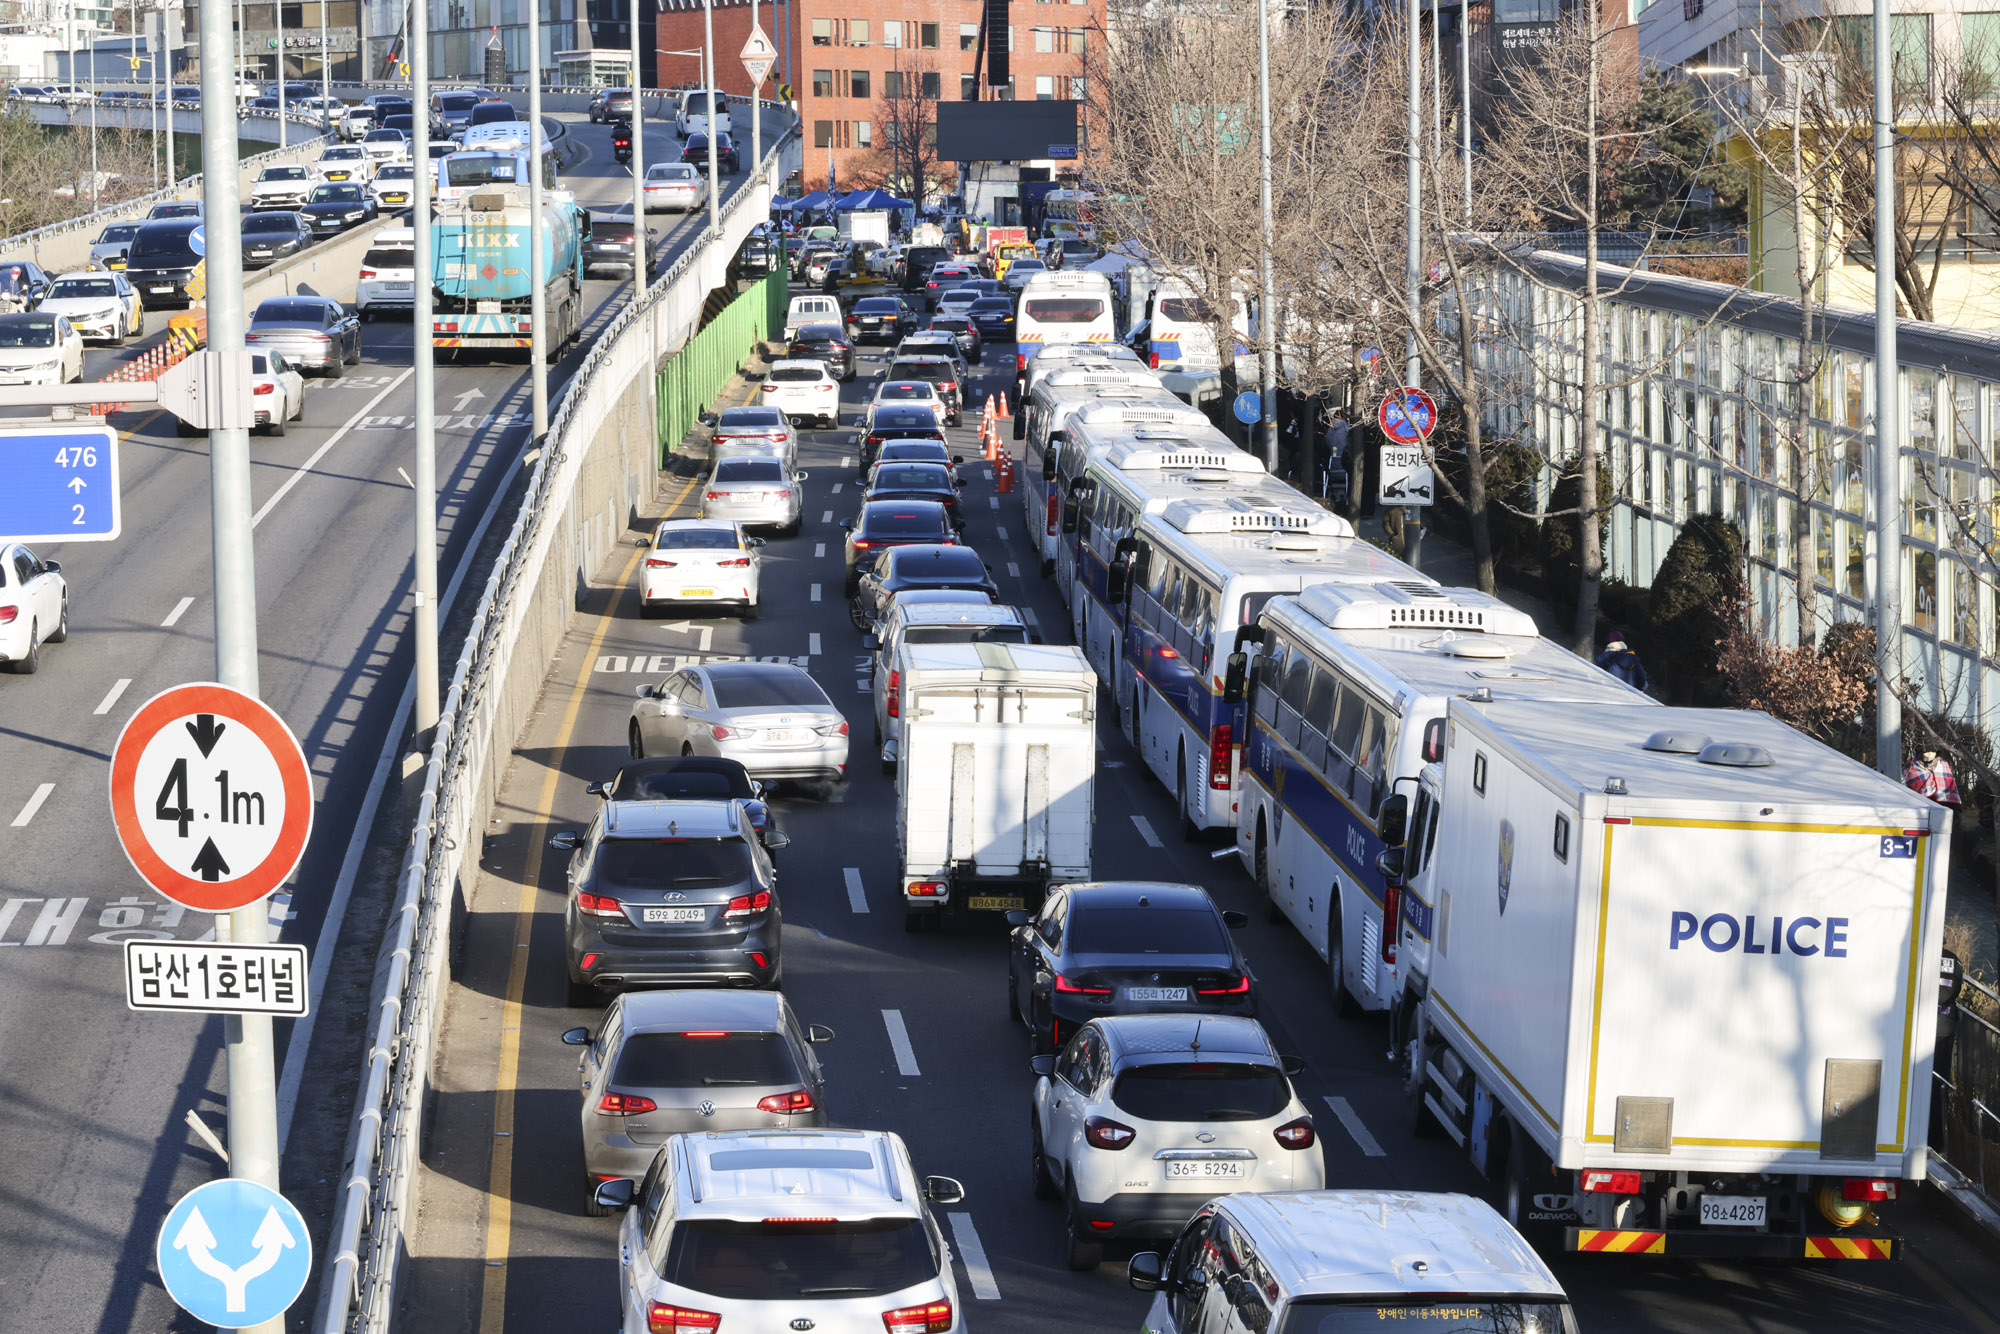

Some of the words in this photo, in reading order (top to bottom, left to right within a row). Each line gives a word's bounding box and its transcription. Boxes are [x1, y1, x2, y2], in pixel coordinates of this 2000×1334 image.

[493, 166, 511, 177] 472
[1387, 409, 1429, 422] 주정금지
[54, 446, 97, 468] 476
[72, 503, 86, 525] 2
[155, 757, 265, 838] 4.1m
[1347, 823, 1366, 867] POLICE
[1882, 838, 1914, 857] 3-1
[649, 909, 669, 920] 59오
[673, 909, 698, 920] 2049
[1669, 910, 1849, 958] POLICE
[1160, 988, 1186, 1000] 1247
[1173, 1162, 1198, 1176] 36주
[1204, 1162, 1237, 1176] 5294
[1528, 1211, 1577, 1221] DAEWOO
[1376, 1307, 1407, 1320] 장애인
[1409, 1307, 1483, 1320] 이동차량입니다.
[792, 1320, 813, 1329] KIA
